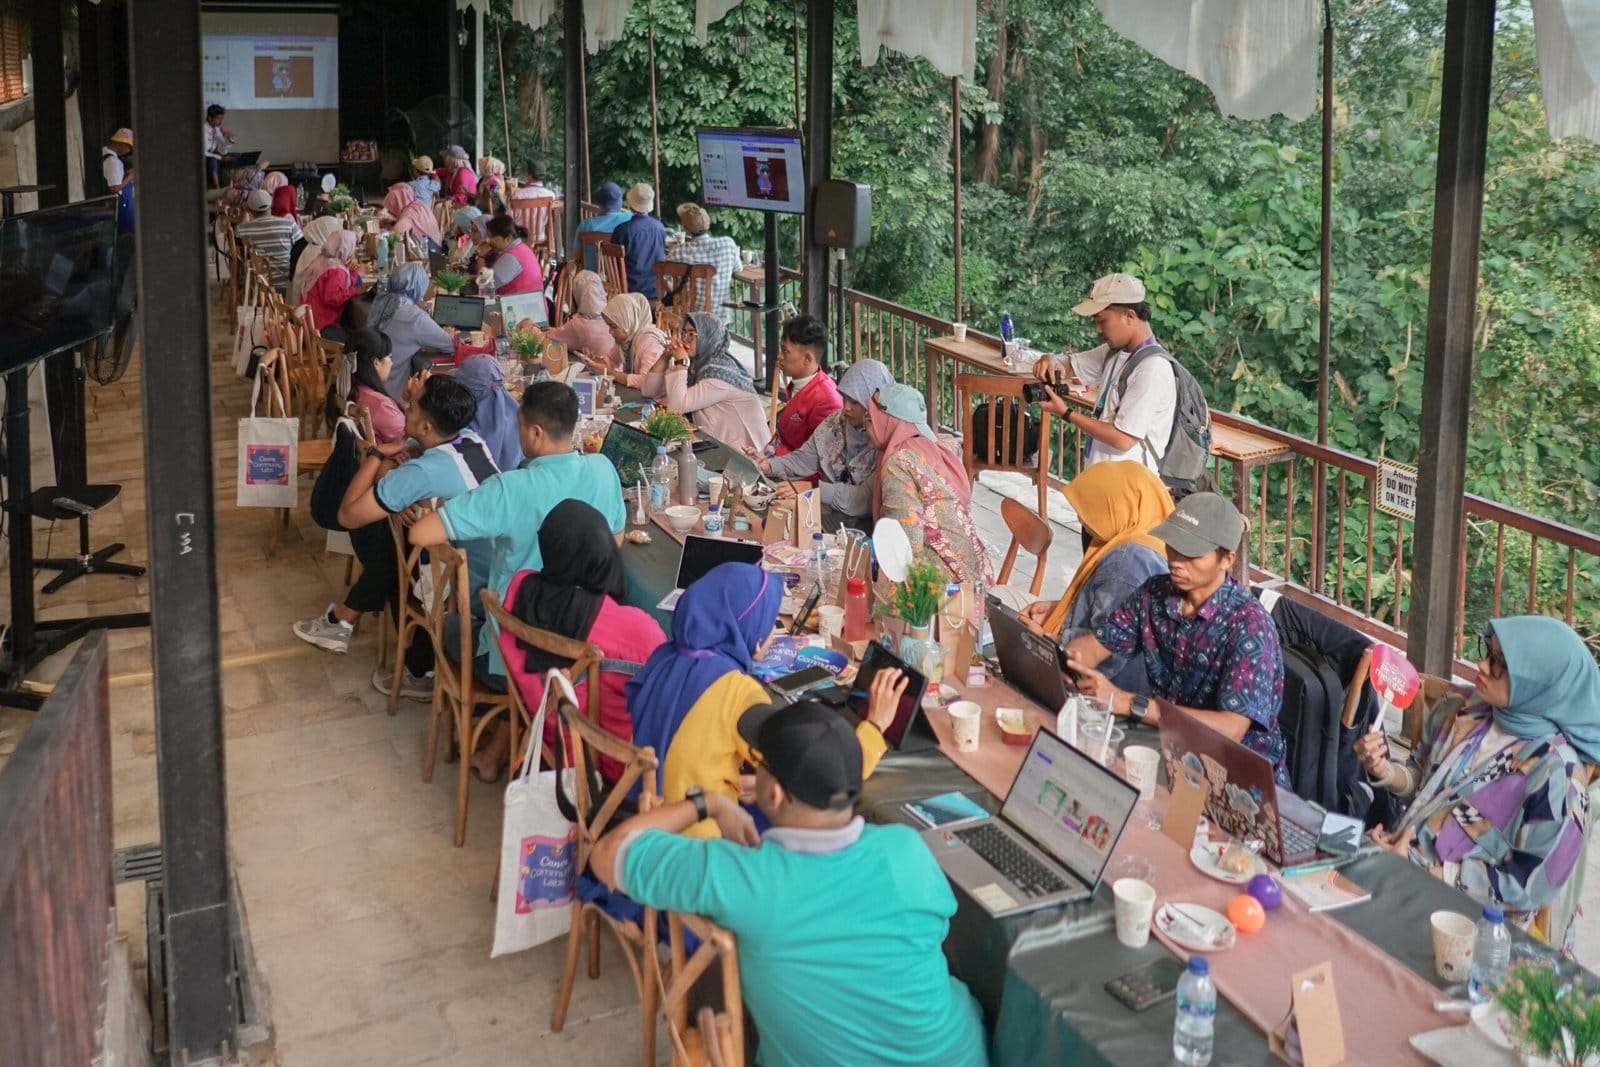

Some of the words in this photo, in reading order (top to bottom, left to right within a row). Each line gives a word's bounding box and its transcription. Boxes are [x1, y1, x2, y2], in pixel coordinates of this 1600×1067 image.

[1387, 478, 1396, 489] DO
[1399, 482, 1412, 496] NOT
[1386, 492, 1395, 503] ON
[1397, 495, 1409, 509] THE
